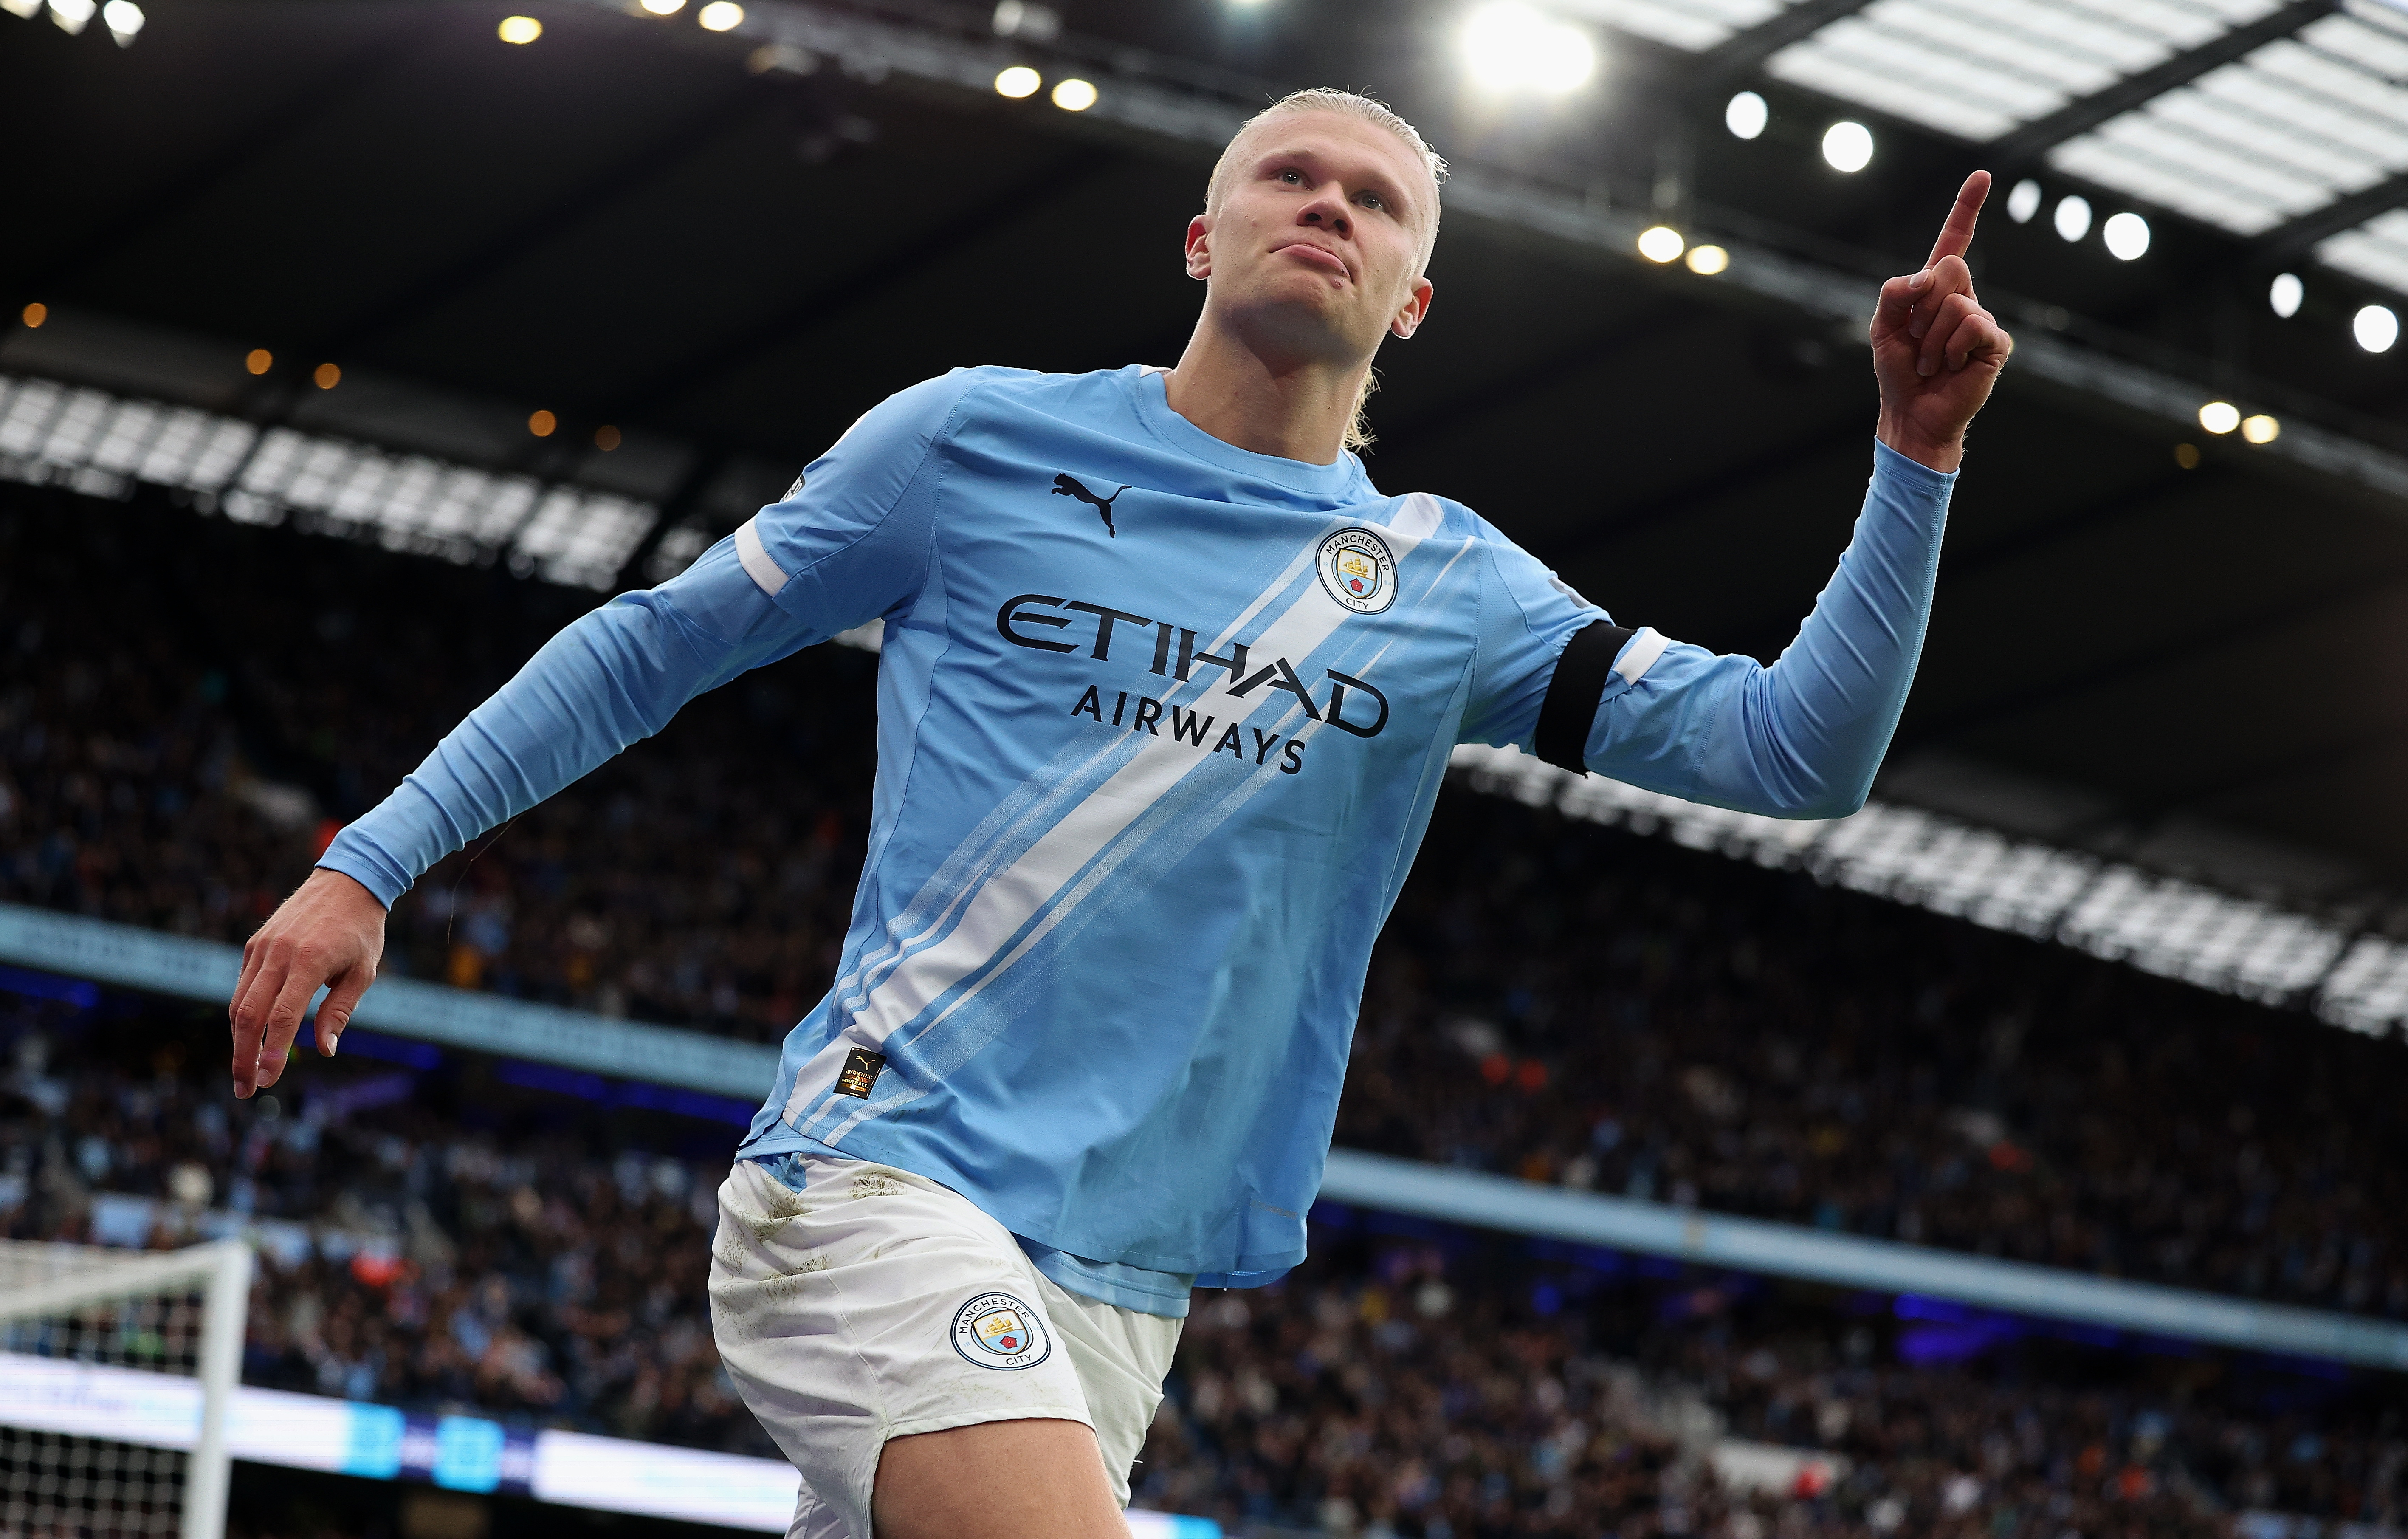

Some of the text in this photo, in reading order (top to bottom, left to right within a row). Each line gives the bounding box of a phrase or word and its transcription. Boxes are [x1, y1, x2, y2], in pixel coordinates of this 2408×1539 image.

[1326, 534, 1390, 571] MANCHESTER
[1346, 598, 1369, 610] CITY
[996, 594, 1389, 738] ETIHAD
[1070, 684, 1306, 775] AIRWAYS
[959, 1298, 1029, 1334] MANCHESTER
[1006, 1354, 1032, 1365] CITY
